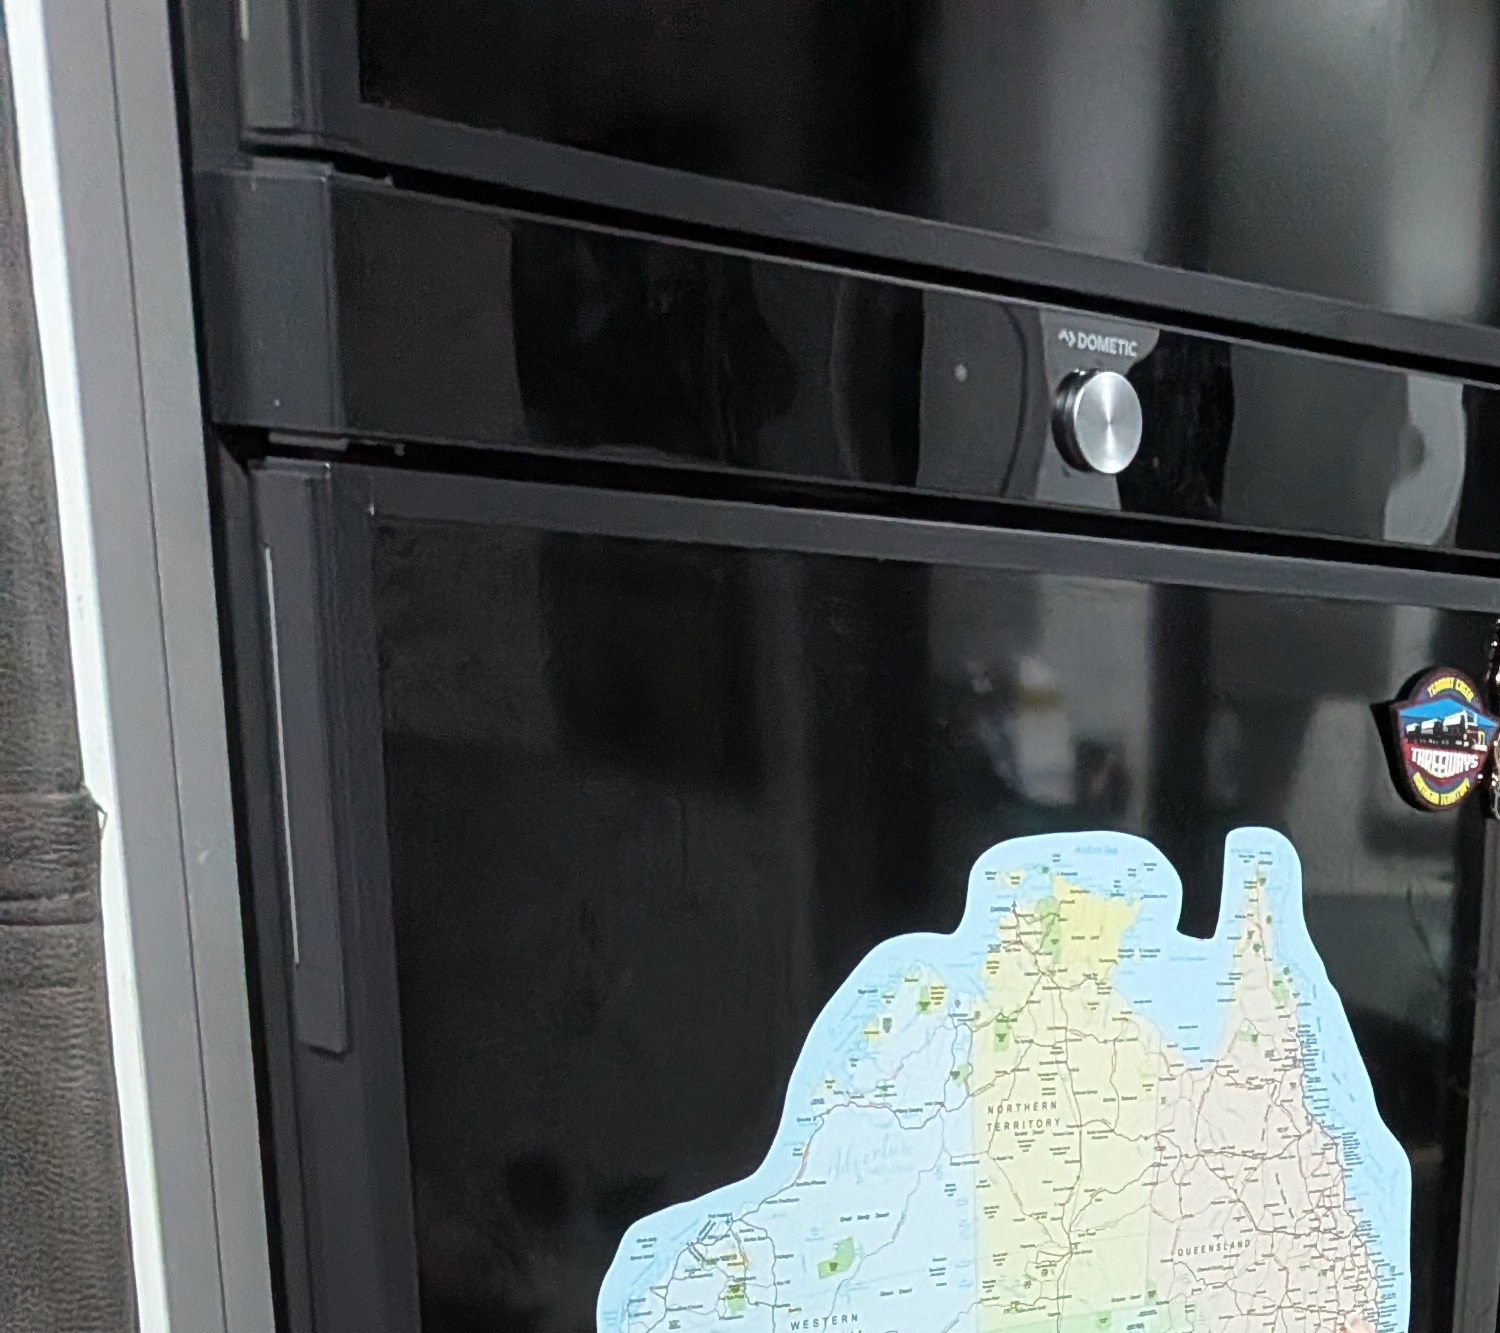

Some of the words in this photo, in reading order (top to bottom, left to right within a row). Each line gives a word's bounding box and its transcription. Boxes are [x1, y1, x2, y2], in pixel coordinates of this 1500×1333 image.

[1077, 332, 1138, 357] DOMETIC
[987, 1101, 1057, 1114] NORTHERN
[987, 1118, 1060, 1132] TERRITORY
[1177, 1239, 1251, 1257] QUEENSLAND
[790, 1313, 859, 1331] WESTERN
